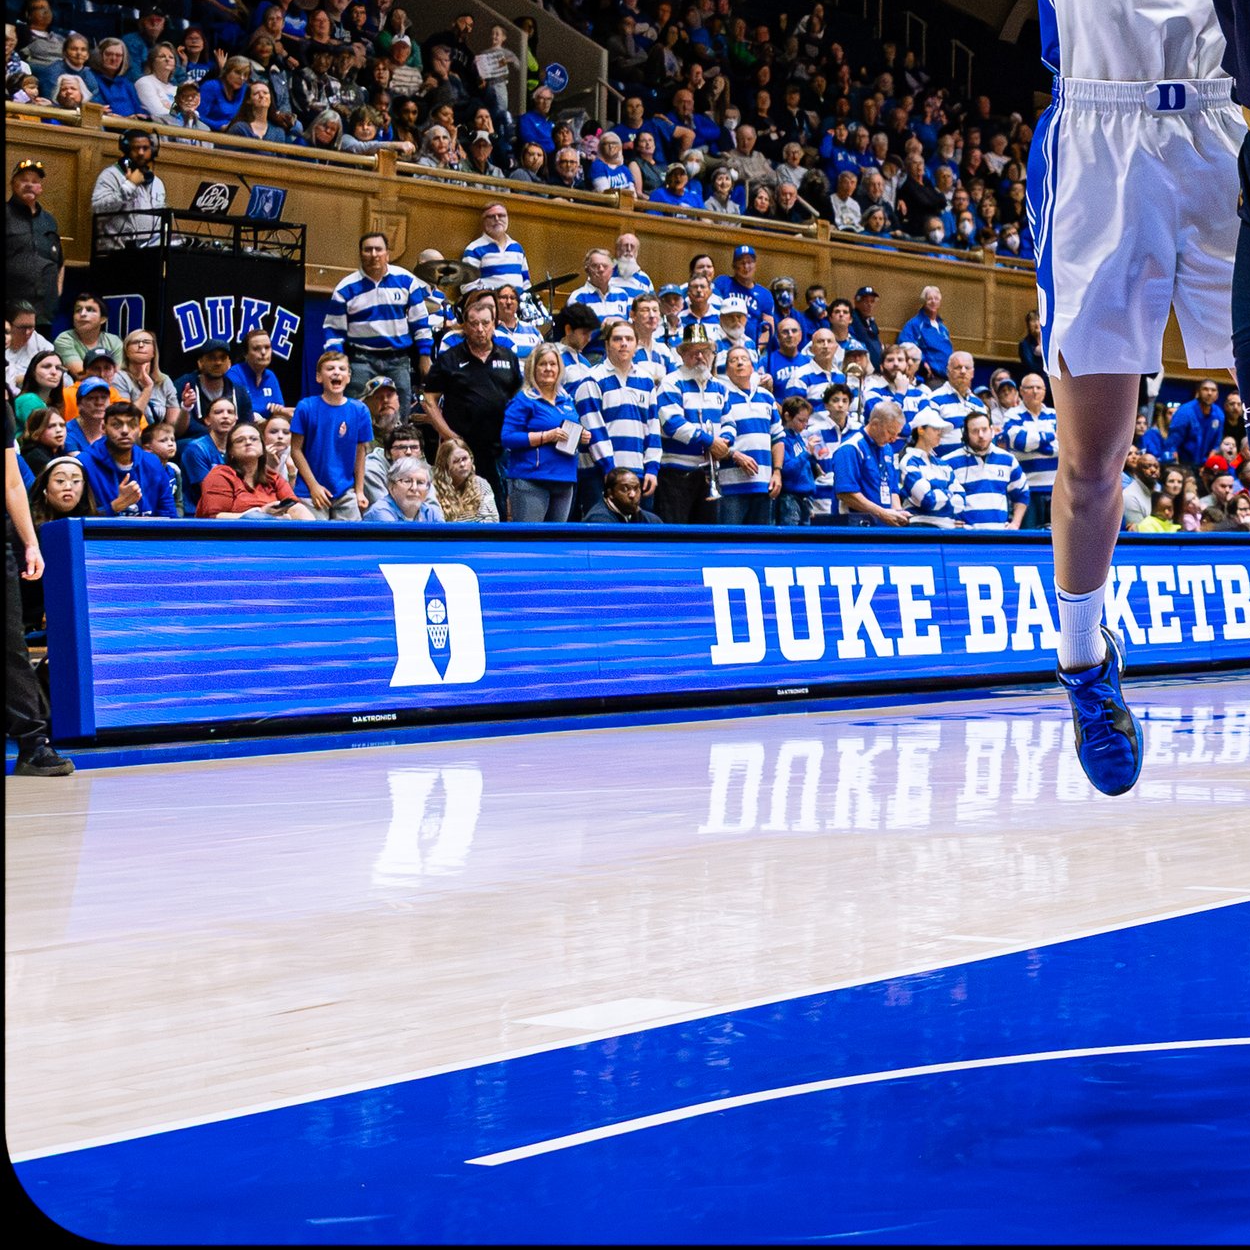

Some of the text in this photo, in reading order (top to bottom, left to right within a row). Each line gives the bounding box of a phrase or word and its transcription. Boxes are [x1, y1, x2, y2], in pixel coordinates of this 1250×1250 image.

[173, 295, 301, 361] DUKE
[702, 566, 943, 665] DUKE
[352, 714, 397, 723] DAKTRONICS
